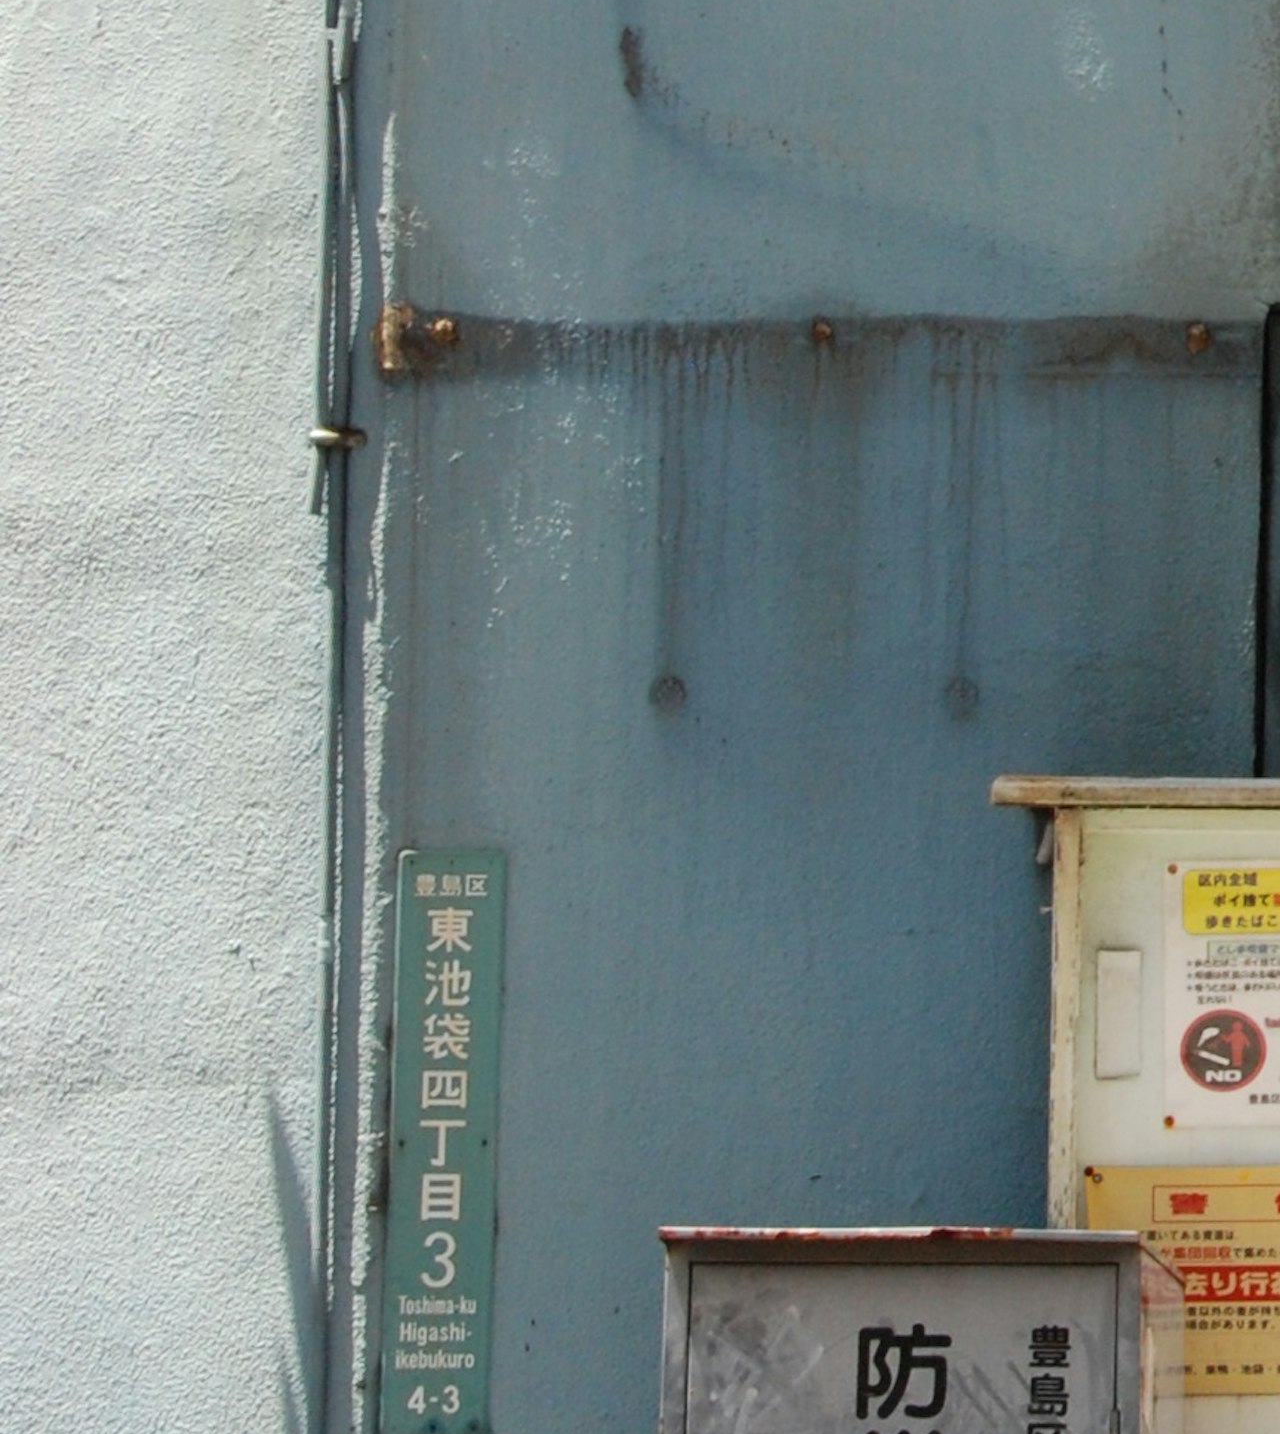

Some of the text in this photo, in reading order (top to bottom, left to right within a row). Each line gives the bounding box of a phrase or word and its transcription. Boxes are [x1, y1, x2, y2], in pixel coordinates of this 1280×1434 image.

[414, 873, 489, 898] 豊島区
[1204, 1068, 1243, 1083] NO
[398, 1293, 478, 1318] Toshima-ku
[398, 1321, 474, 1348] Higashi-
[394, 1349, 476, 1371] ikebukuro
[407, 1383, 461, 1417] 4-3
